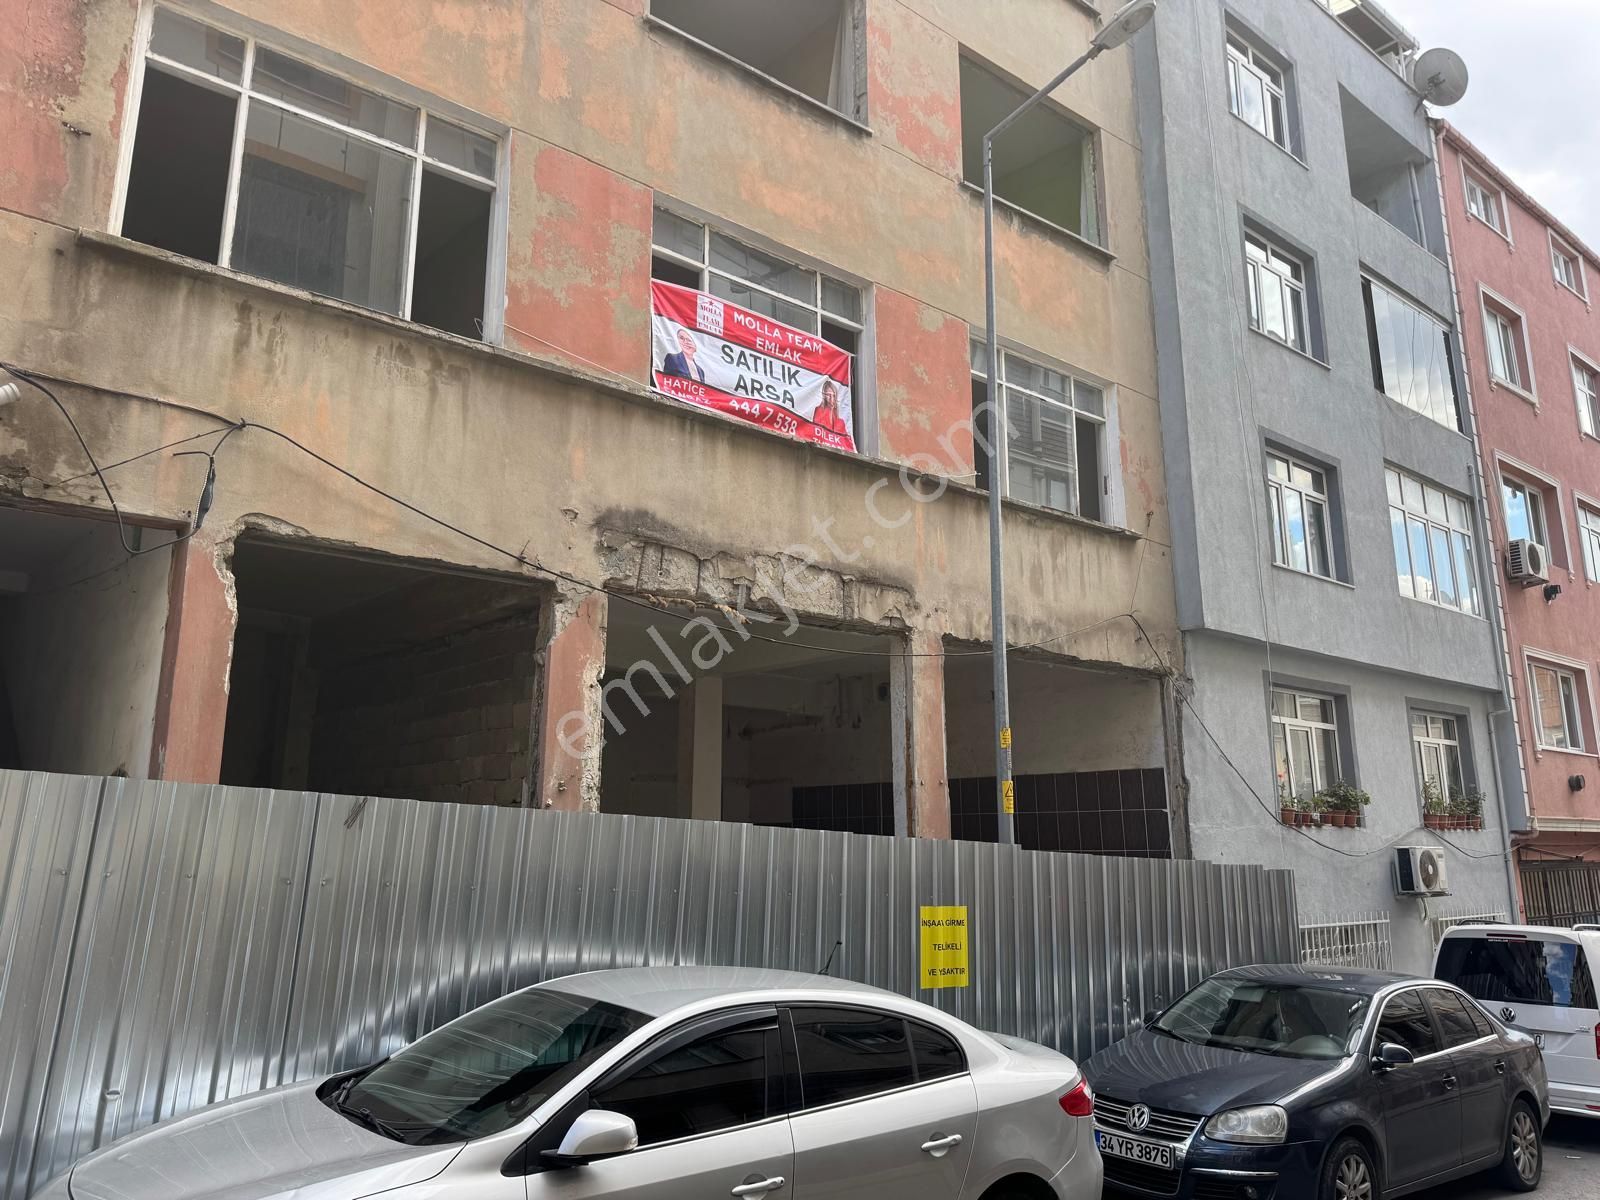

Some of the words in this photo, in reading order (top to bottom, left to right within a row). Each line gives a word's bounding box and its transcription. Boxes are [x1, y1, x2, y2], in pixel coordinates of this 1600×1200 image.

[733, 311, 783, 341] MOLLA
[786, 332, 823, 355] TEAM
[721, 343, 803, 388] SATILIK
[756, 336, 802, 364] EMLAK
[663, 377, 706, 397] HATİCE
[734, 374, 795, 409] ARSA
[729, 399, 760, 419] 444
[762, 406, 774, 422] 7
[773, 412, 798, 436] 538
[945, 917, 965, 927] GİRME
[928, 968, 937, 977] VE
[1100, 1134, 1114, 1152] 34
[1116, 1138, 1134, 1157] YR
[1136, 1143, 1169, 1165] 3876
